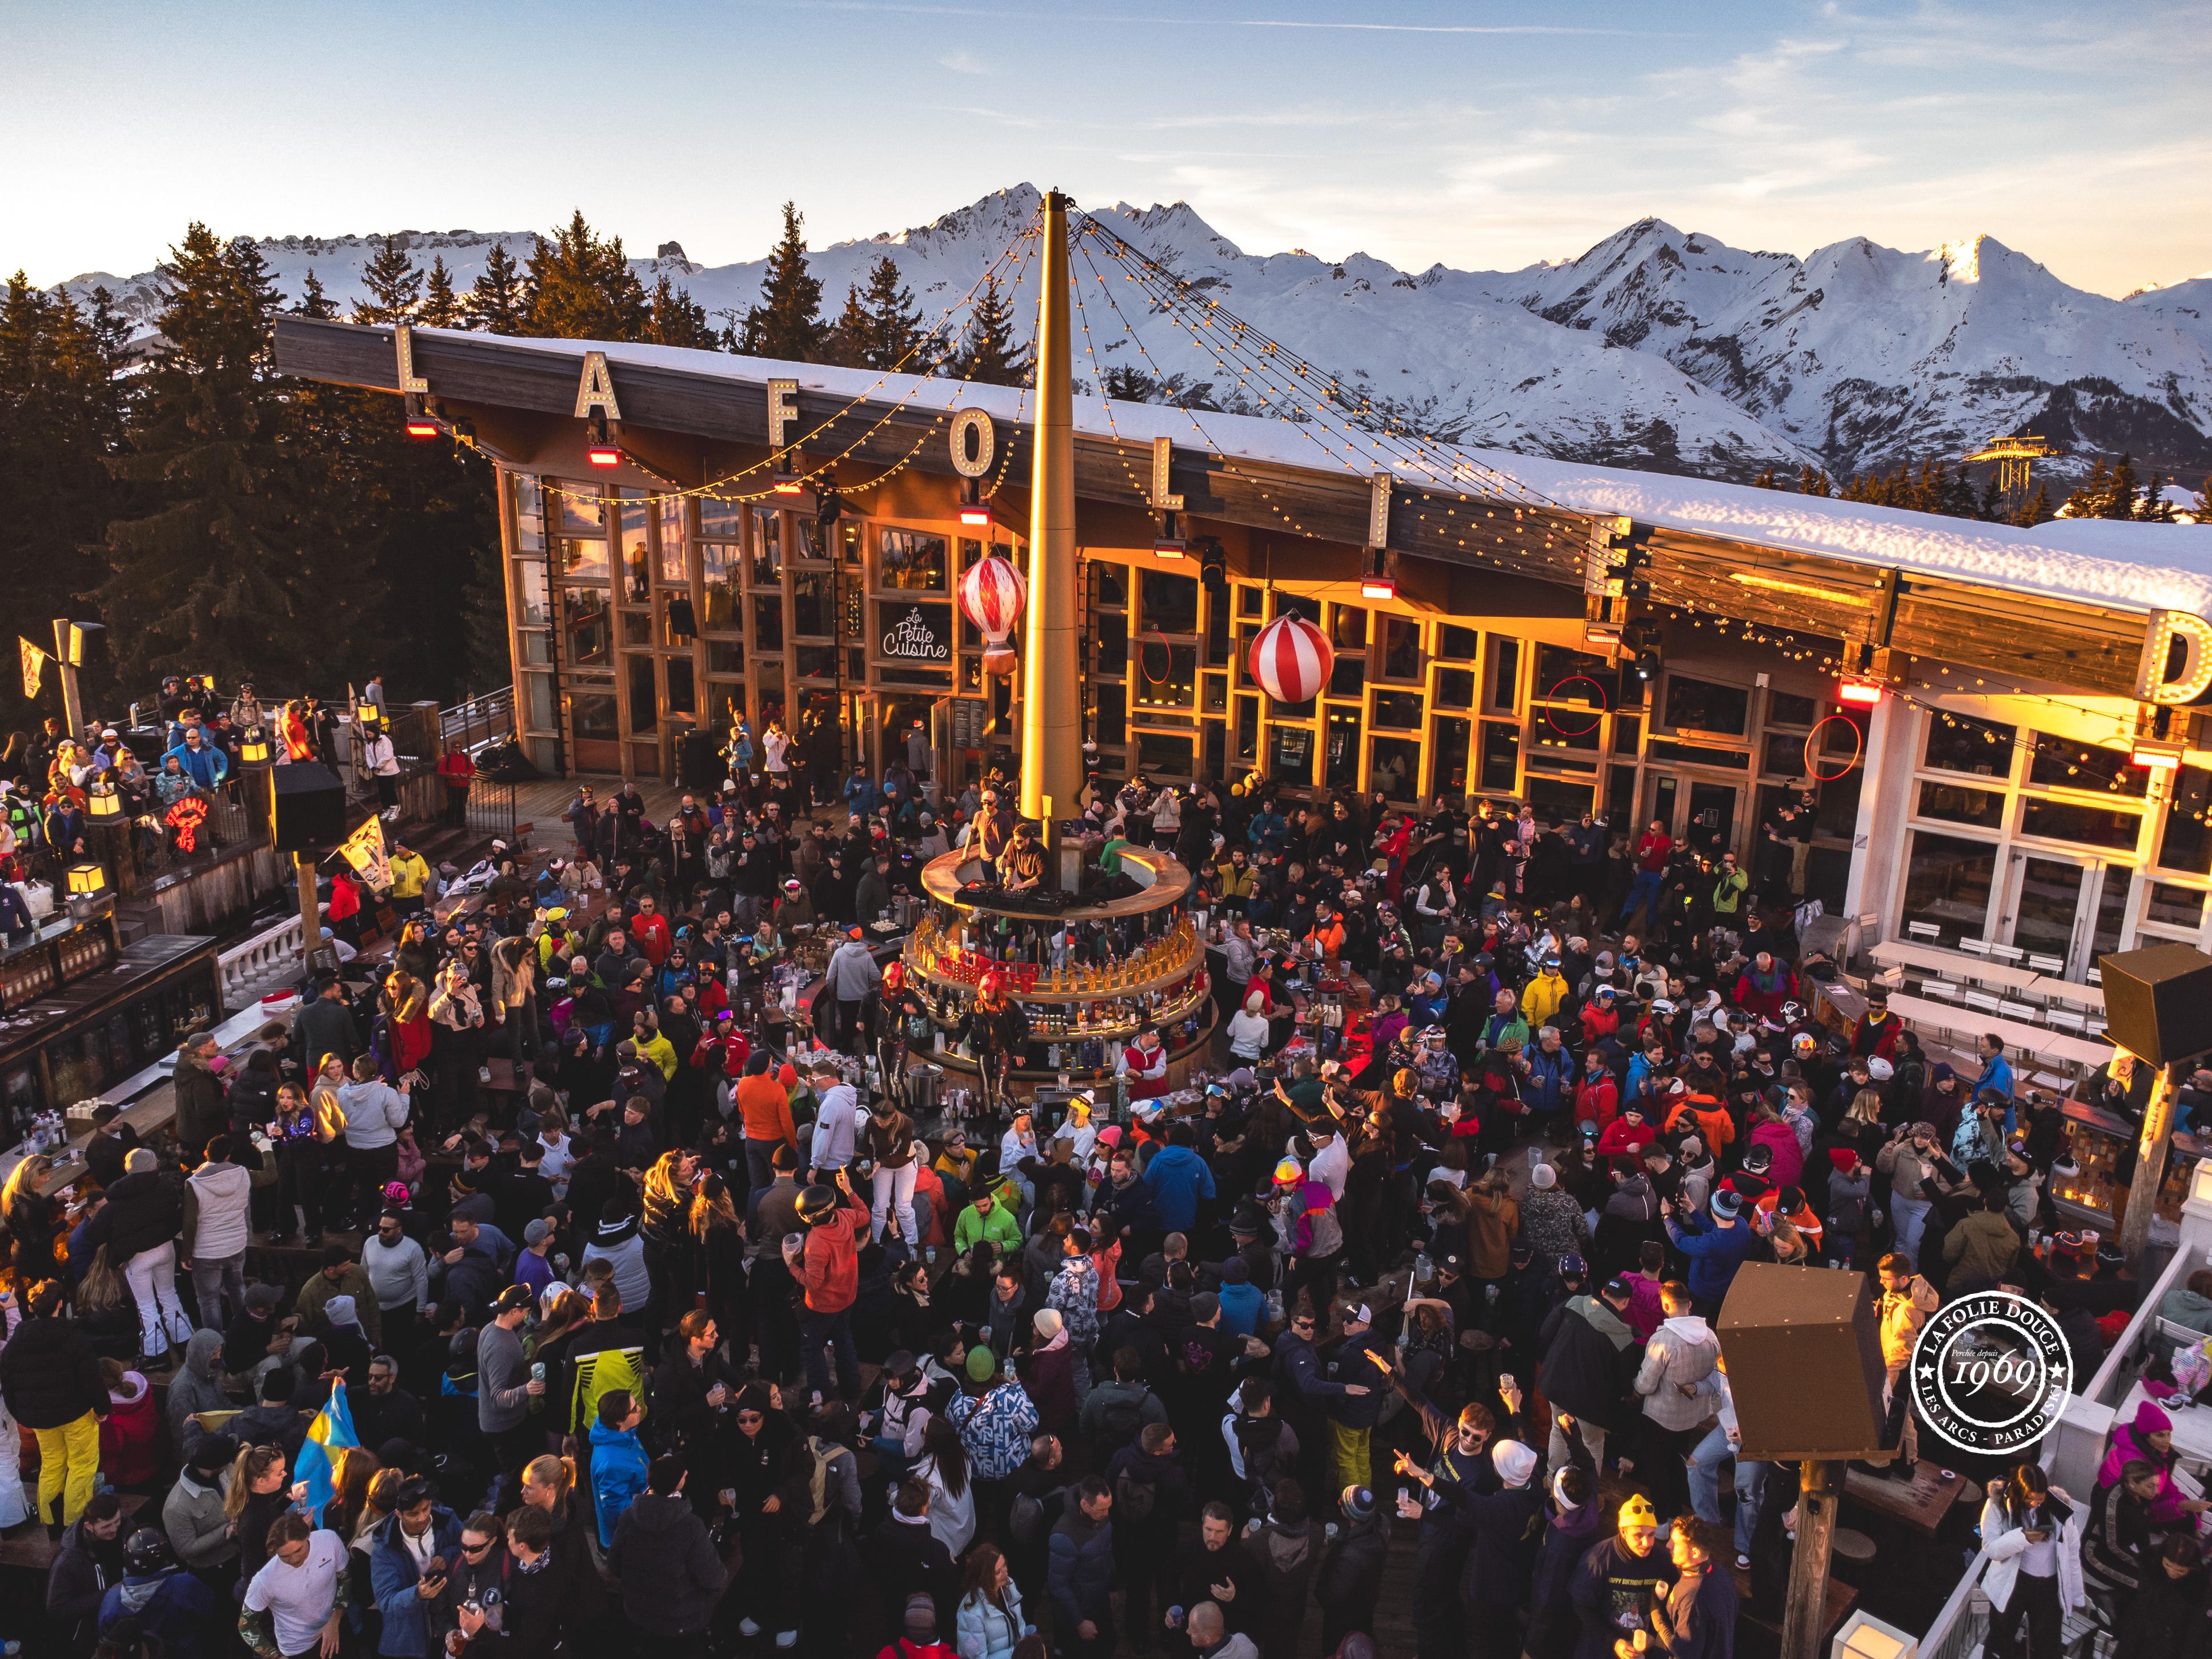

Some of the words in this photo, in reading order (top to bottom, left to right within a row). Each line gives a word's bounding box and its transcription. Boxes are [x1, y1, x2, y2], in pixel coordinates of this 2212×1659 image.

[906, 607, 922, 624] La
[896, 622, 934, 643] Petite
[883, 632, 948, 658] Cuisine
